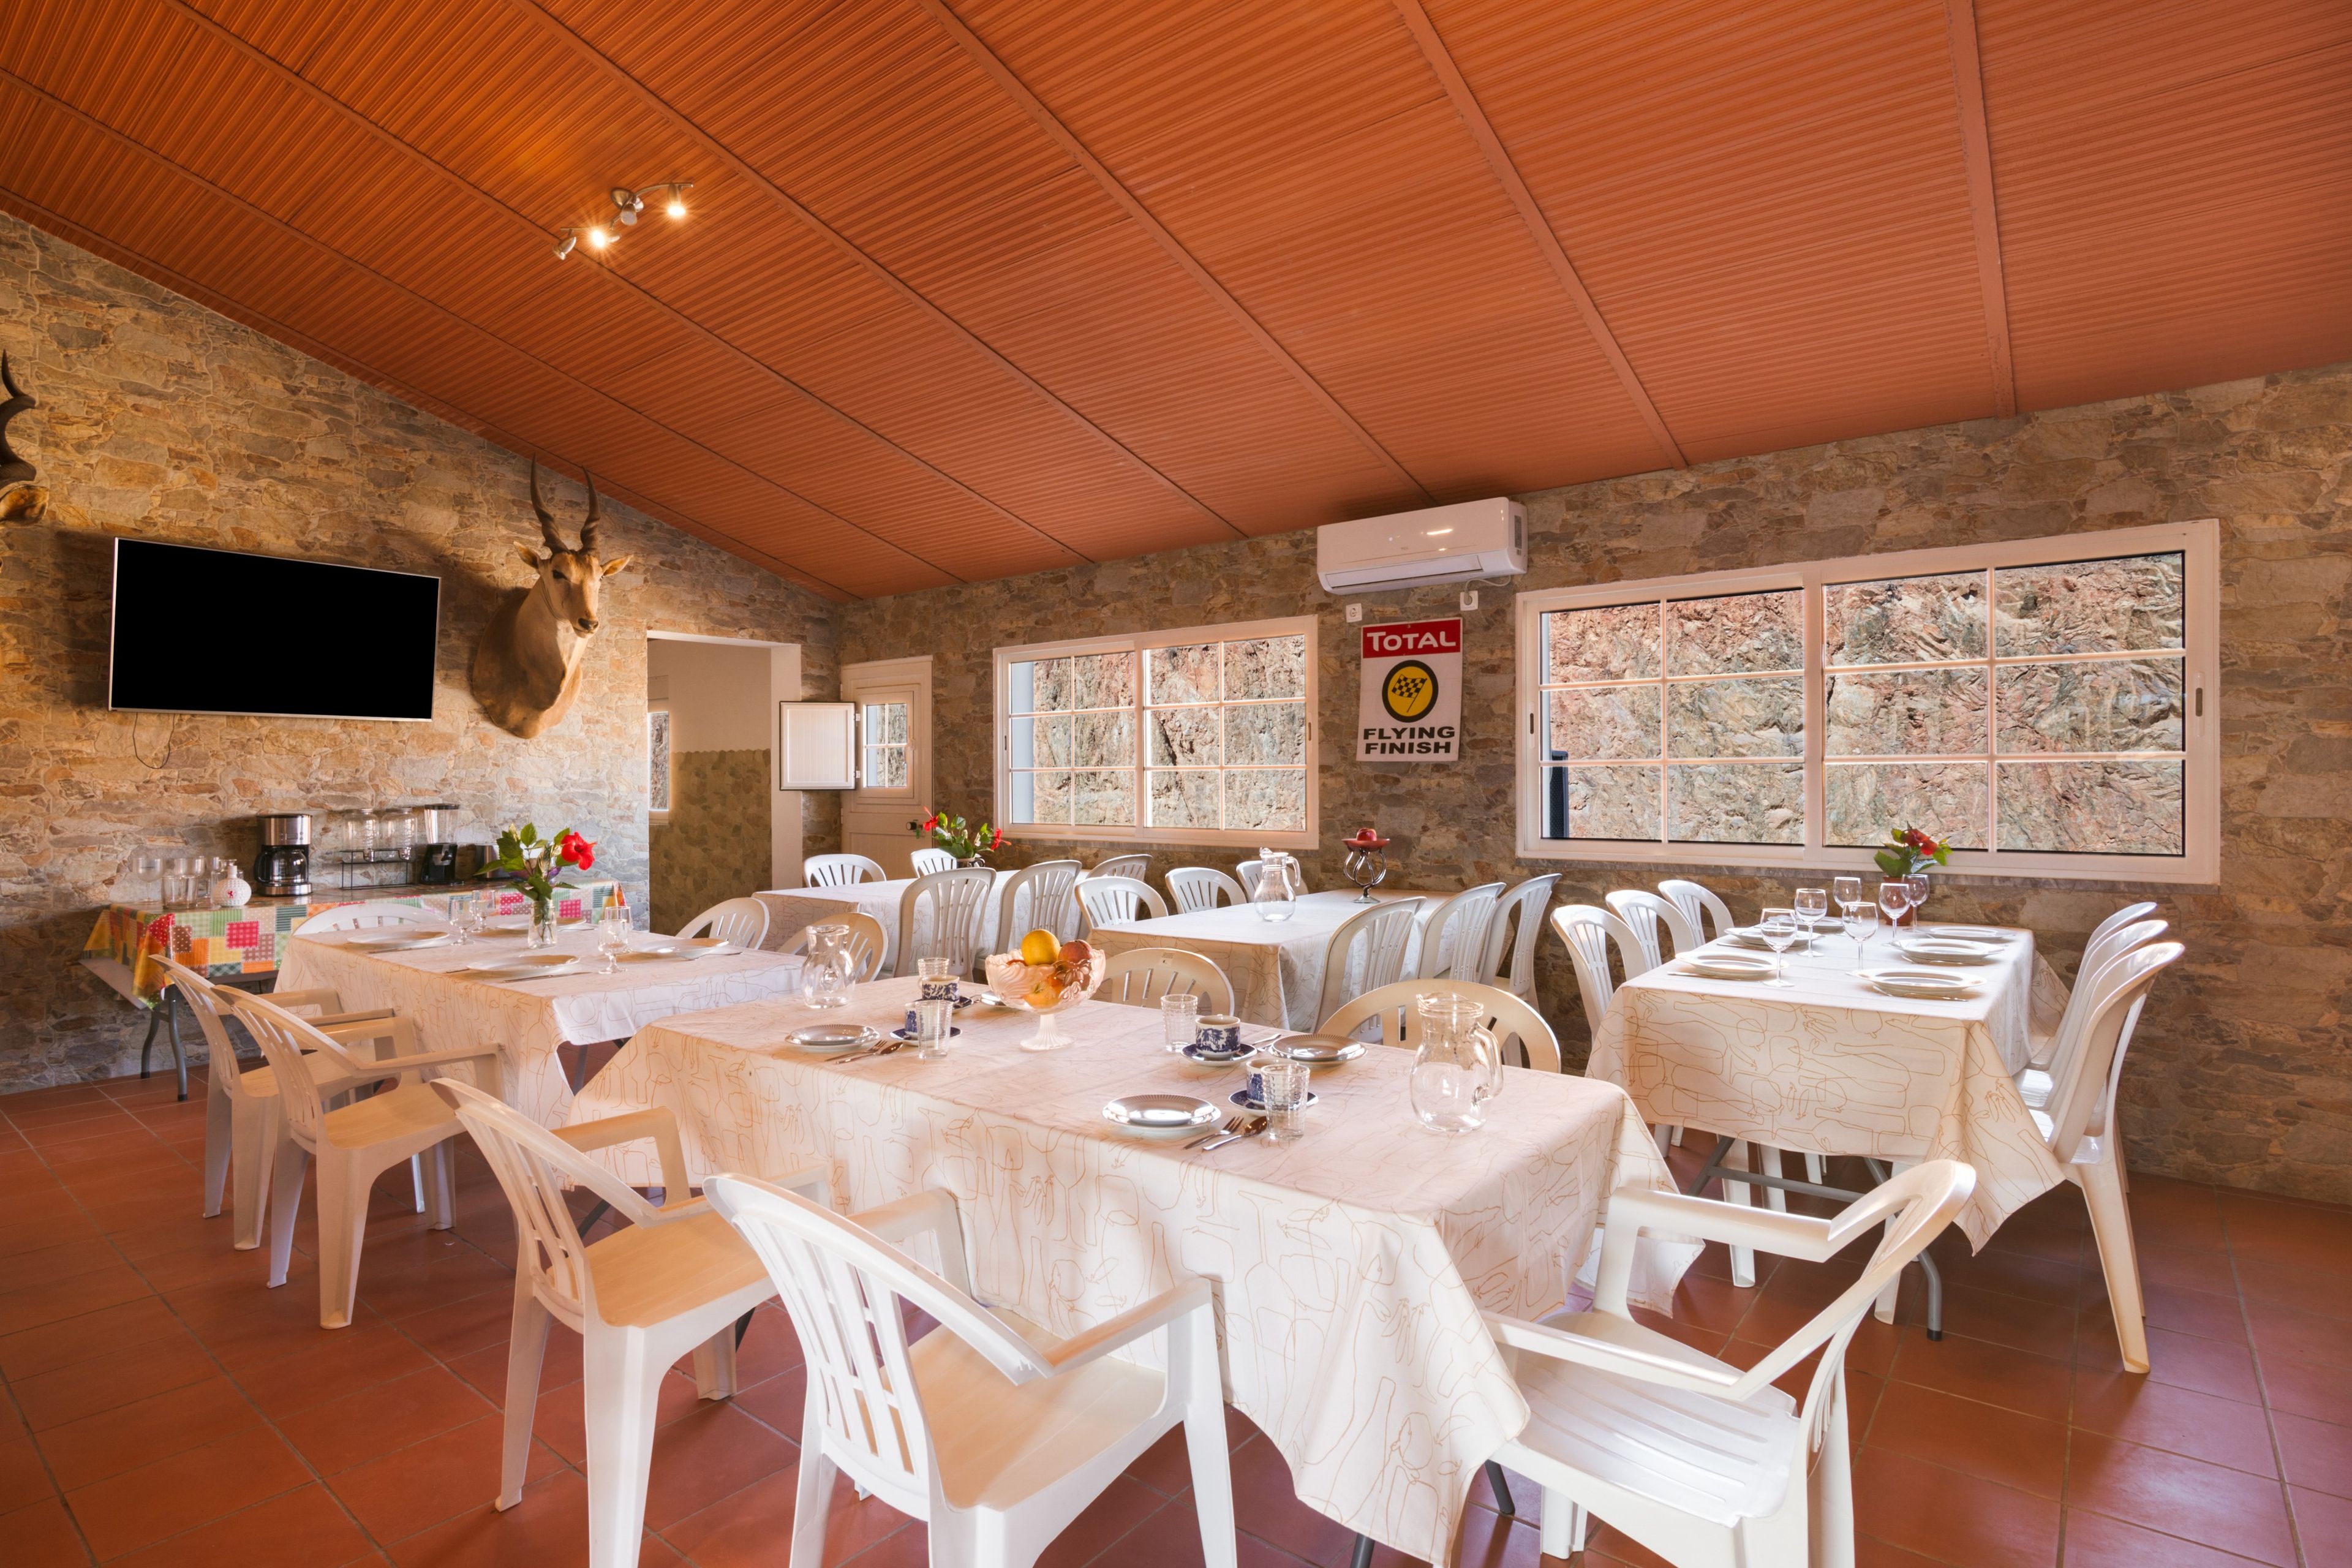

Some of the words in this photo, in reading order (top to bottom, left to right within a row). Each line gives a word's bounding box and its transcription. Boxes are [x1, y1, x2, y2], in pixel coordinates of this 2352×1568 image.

[1366, 631, 1457, 652] TOTAL
[1363, 726, 1455, 740] FLYING
[1365, 742, 1451, 755] FINISH
